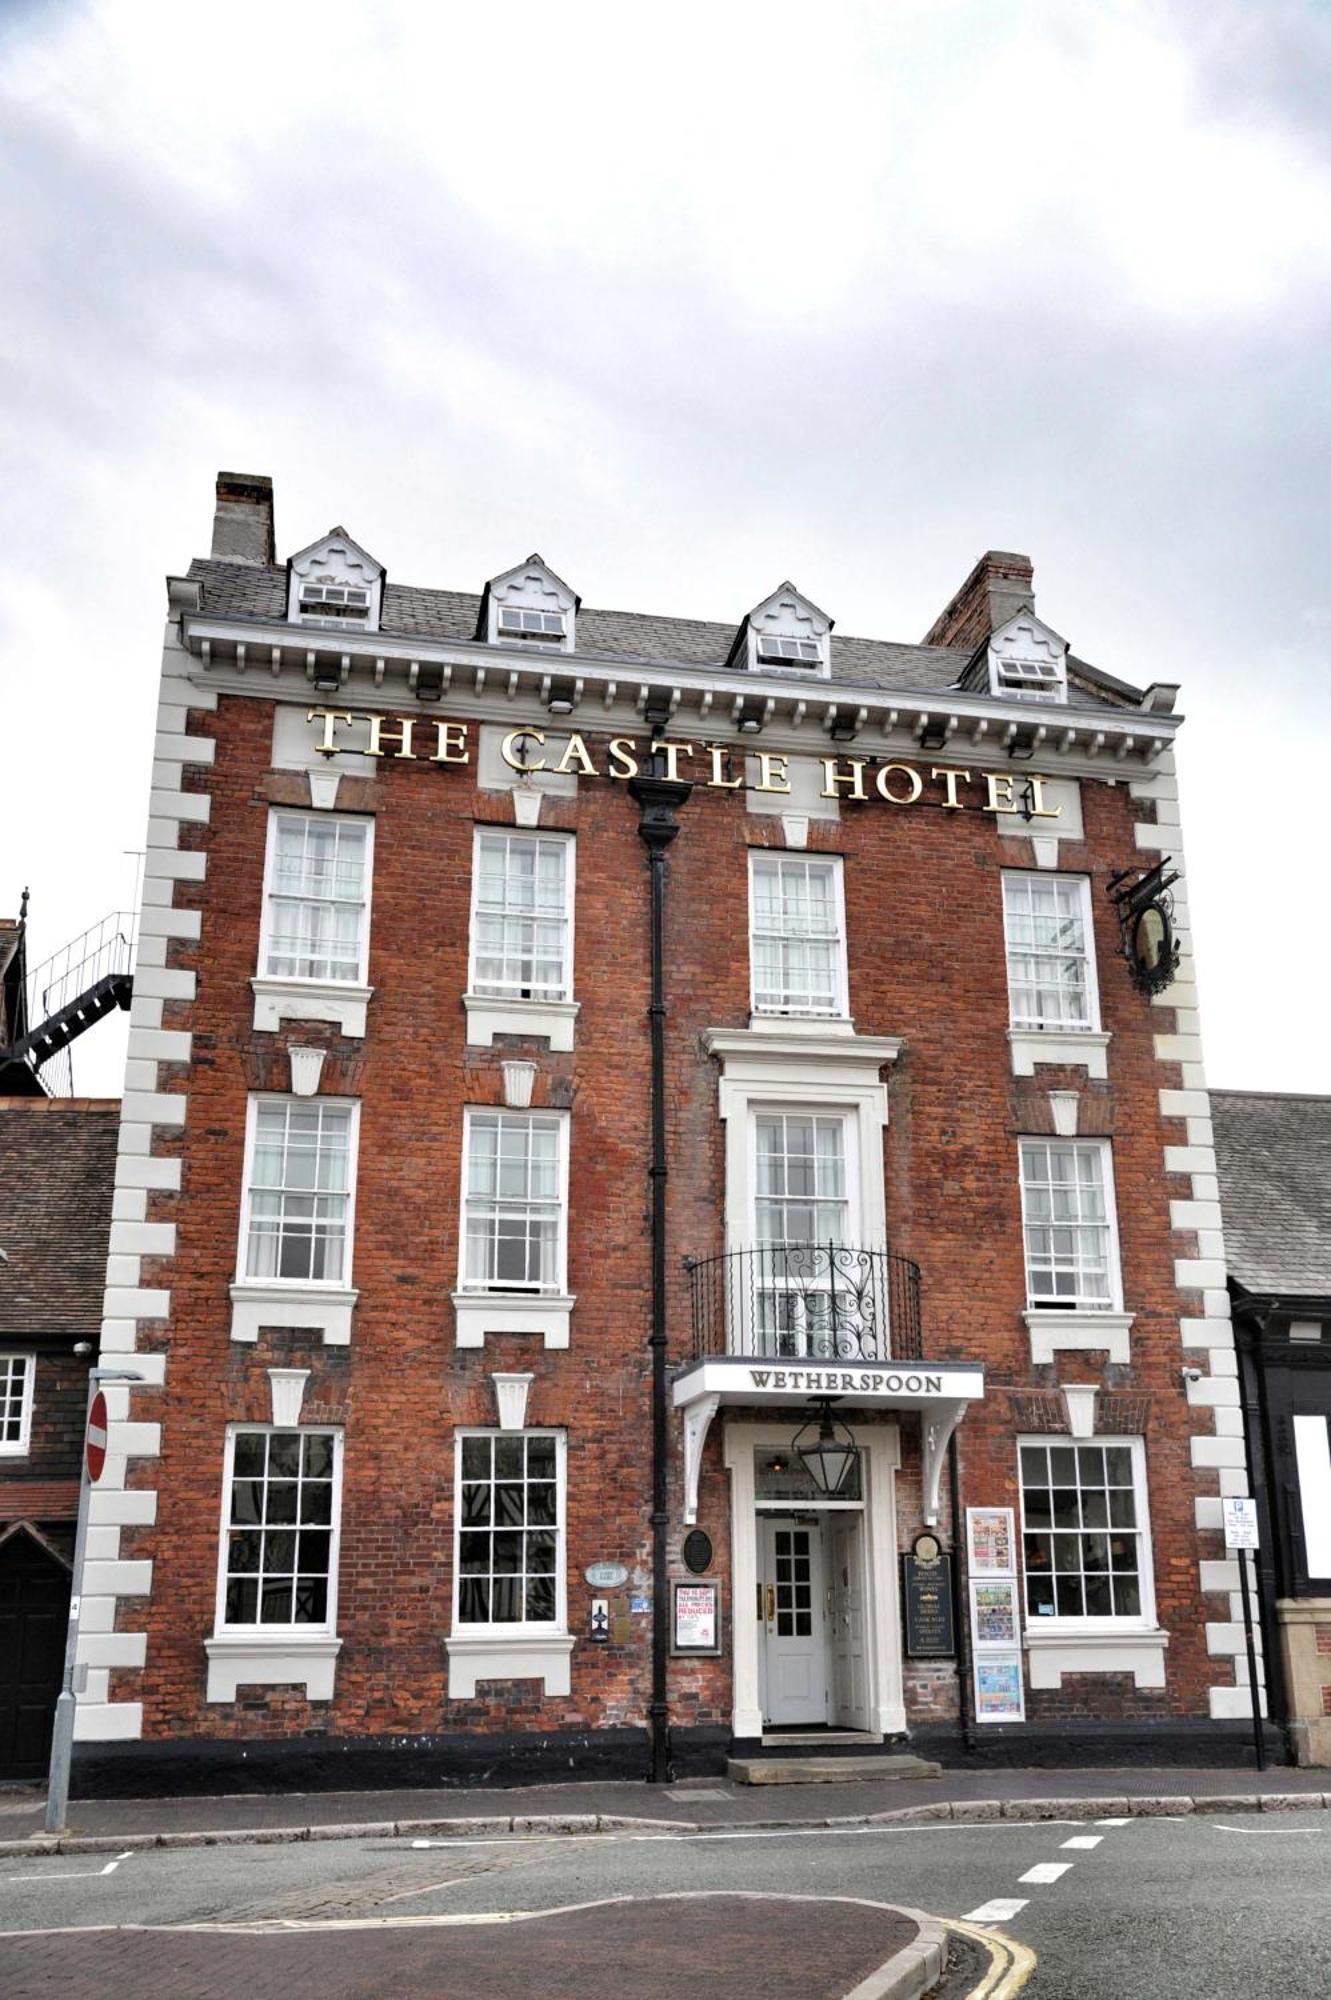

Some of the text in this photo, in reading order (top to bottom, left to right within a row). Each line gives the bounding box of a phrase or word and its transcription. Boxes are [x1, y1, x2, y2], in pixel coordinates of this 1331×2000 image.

[306, 708, 1064, 818] THE CASTLE HOTEL
[749, 1370, 943, 1393] WETHERSPOON
